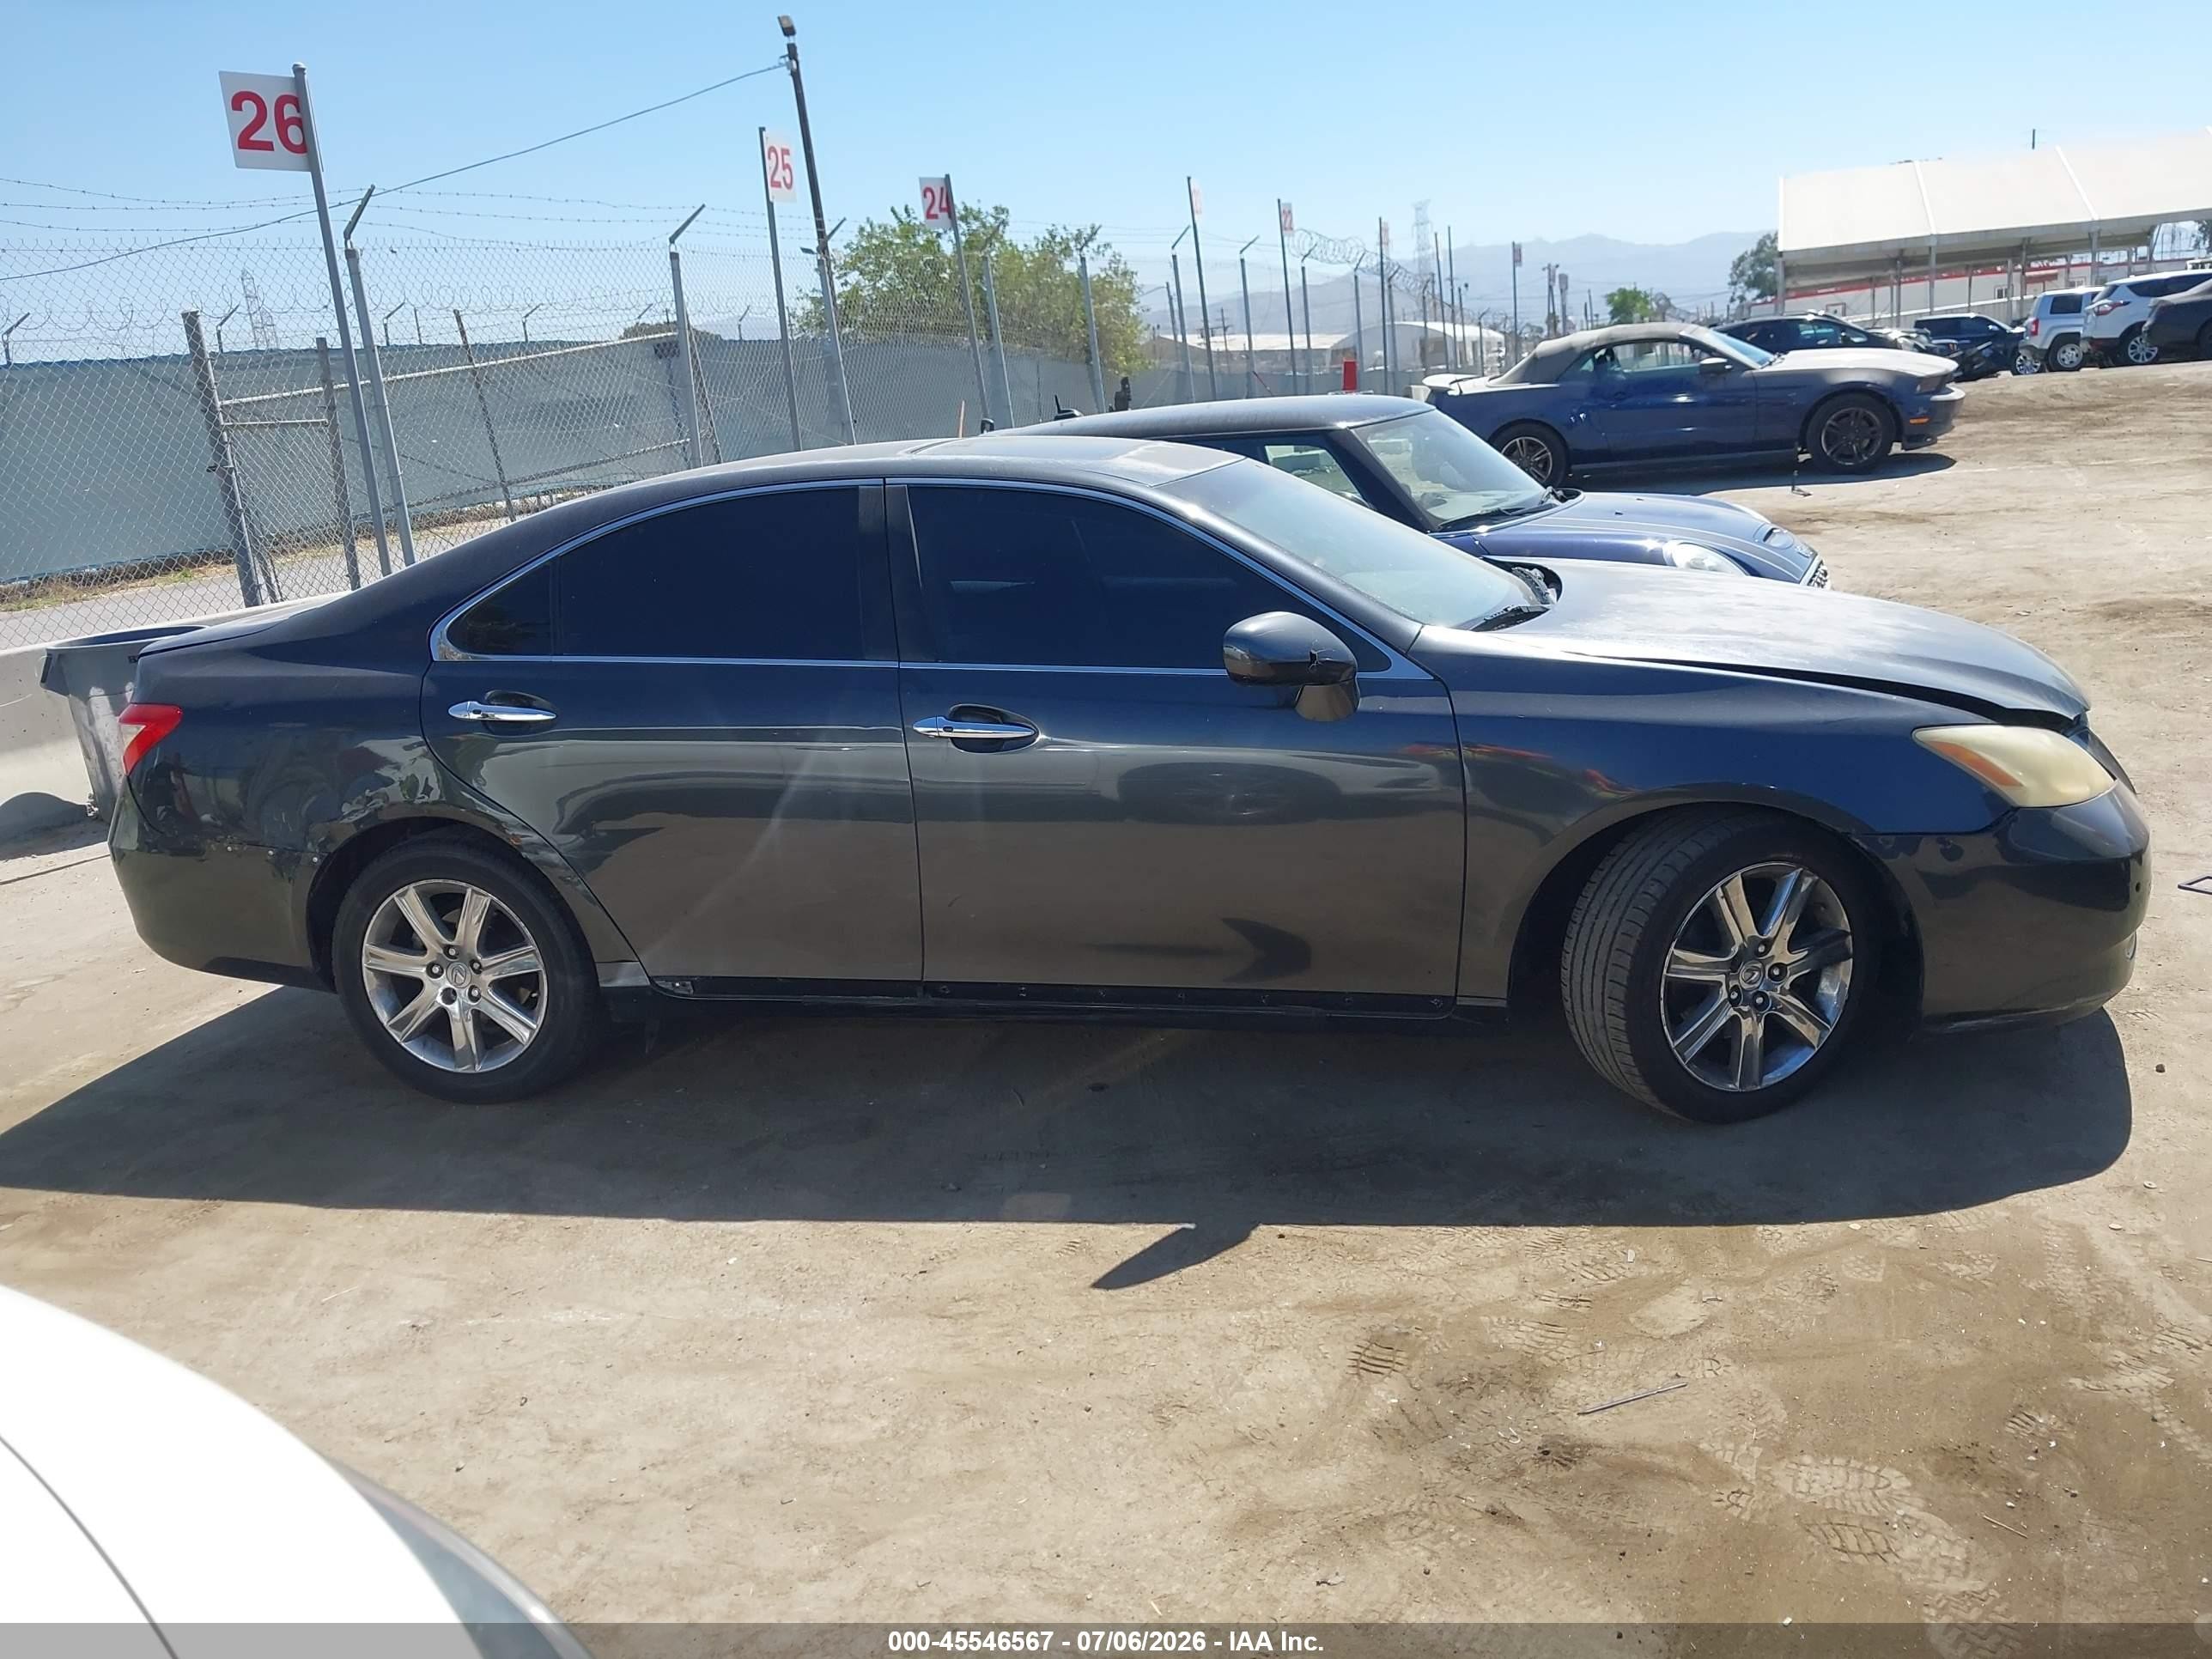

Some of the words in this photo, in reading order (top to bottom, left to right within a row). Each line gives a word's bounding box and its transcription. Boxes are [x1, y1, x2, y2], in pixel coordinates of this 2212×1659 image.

[231, 90, 307, 155] 26
[767, 145, 793, 190] 25
[923, 186, 951, 220] 24
